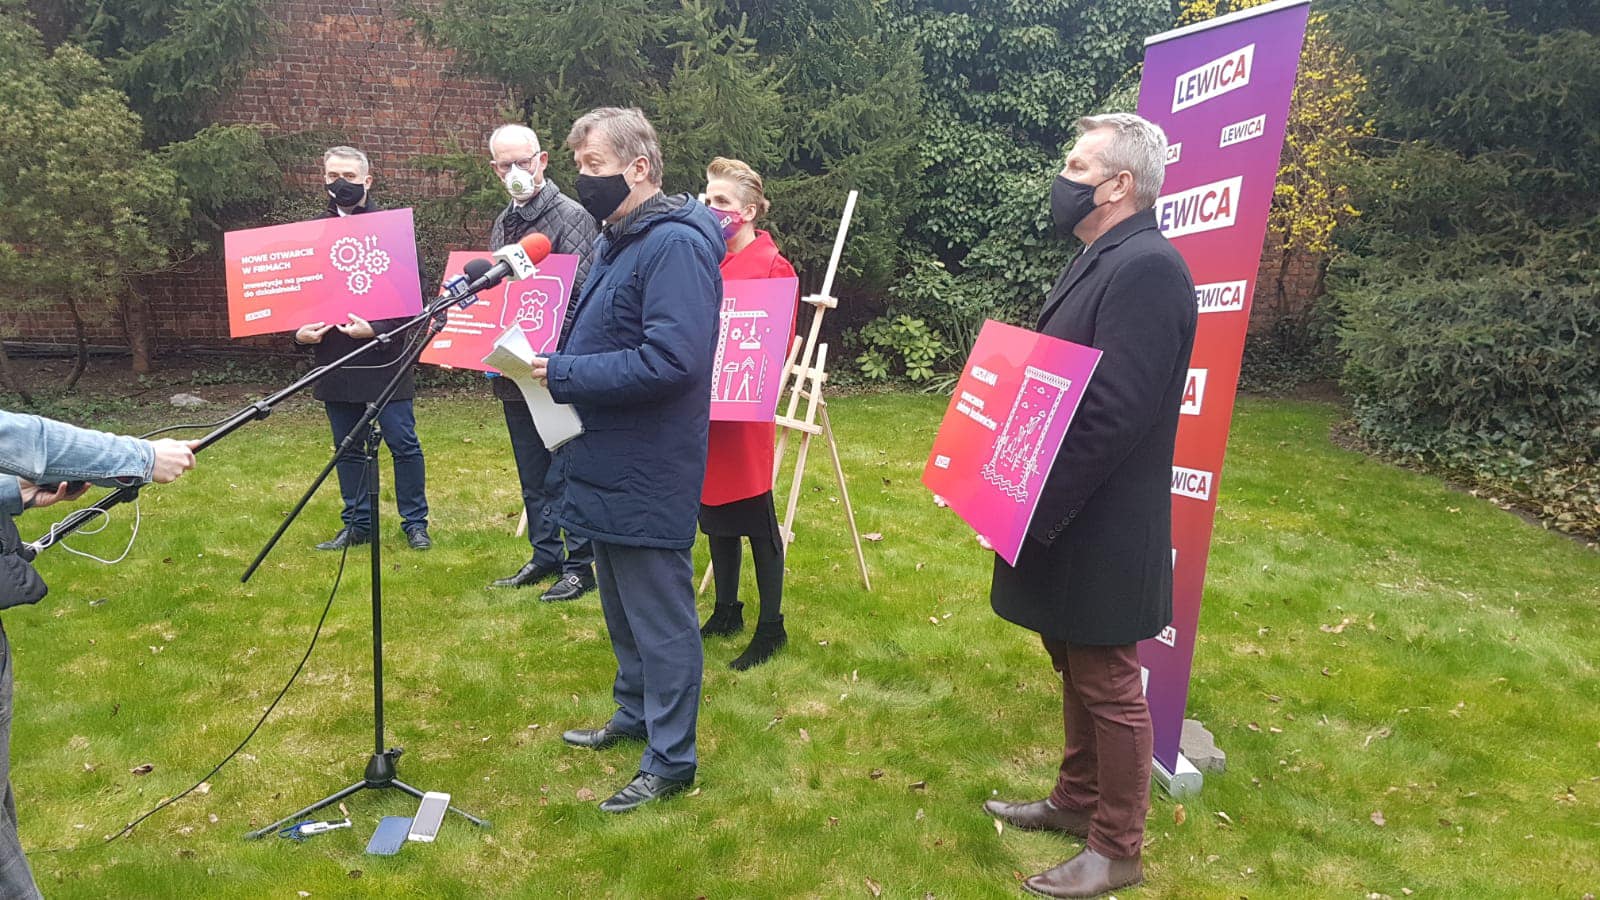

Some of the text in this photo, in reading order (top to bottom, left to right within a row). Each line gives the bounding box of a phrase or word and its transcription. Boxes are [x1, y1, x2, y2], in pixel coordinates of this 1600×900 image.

[1177, 54, 1246, 104] LEWICA
[1222, 119, 1261, 143] LEWICA
[1159, 187, 1231, 231] EWICA
[1195, 285, 1241, 308] EWICA
[1170, 471, 1207, 495] WICA
